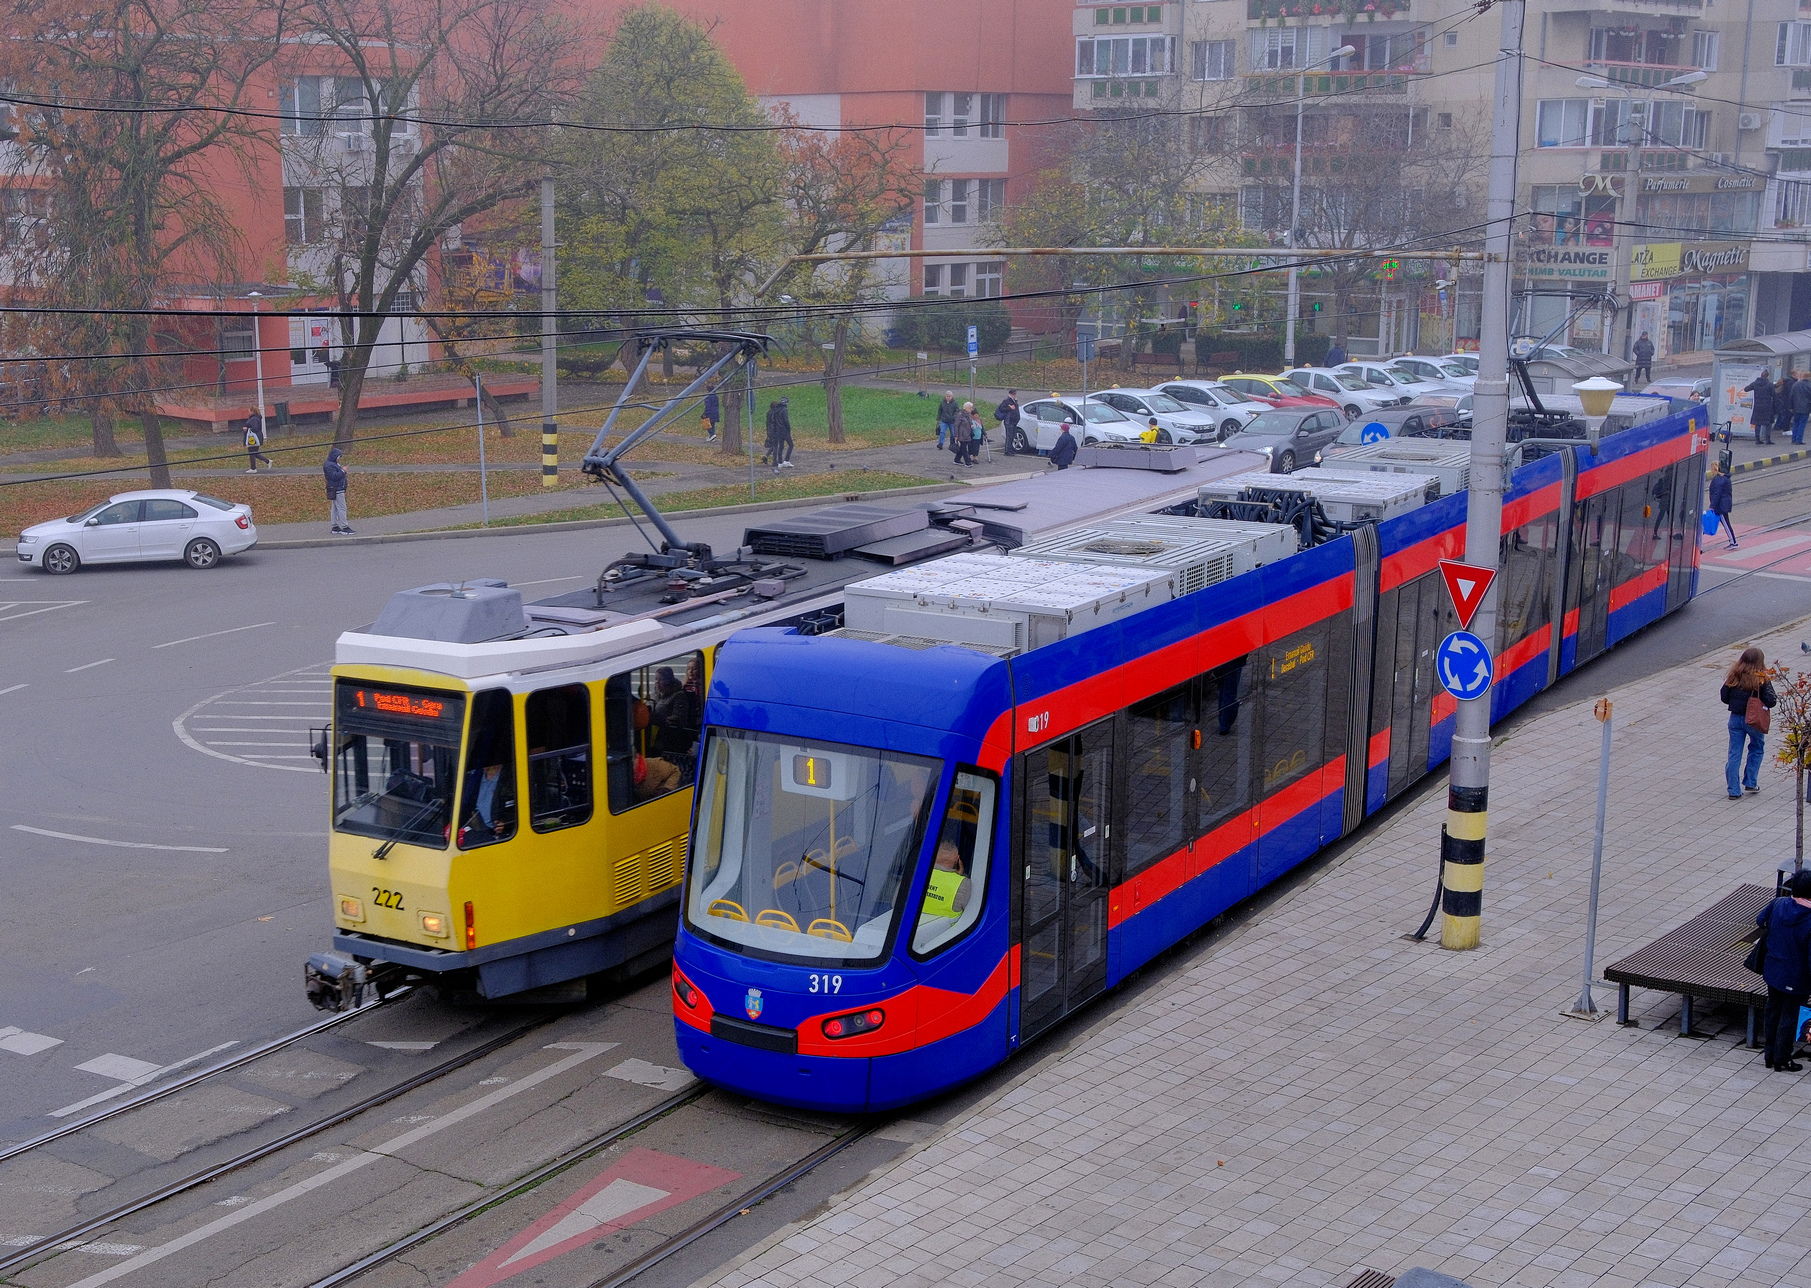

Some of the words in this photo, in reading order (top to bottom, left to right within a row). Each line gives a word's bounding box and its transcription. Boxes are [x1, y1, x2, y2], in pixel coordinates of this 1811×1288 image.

[1515, 249, 1609, 265] EXCHANGE
[1684, 245, 1747, 274] Magnetic
[1640, 265, 1678, 279] EXCHANGE
[356, 690, 366, 707] 1
[806, 757, 816, 785] 1
[372, 886, 405, 911] 222
[808, 974, 843, 994] 319
